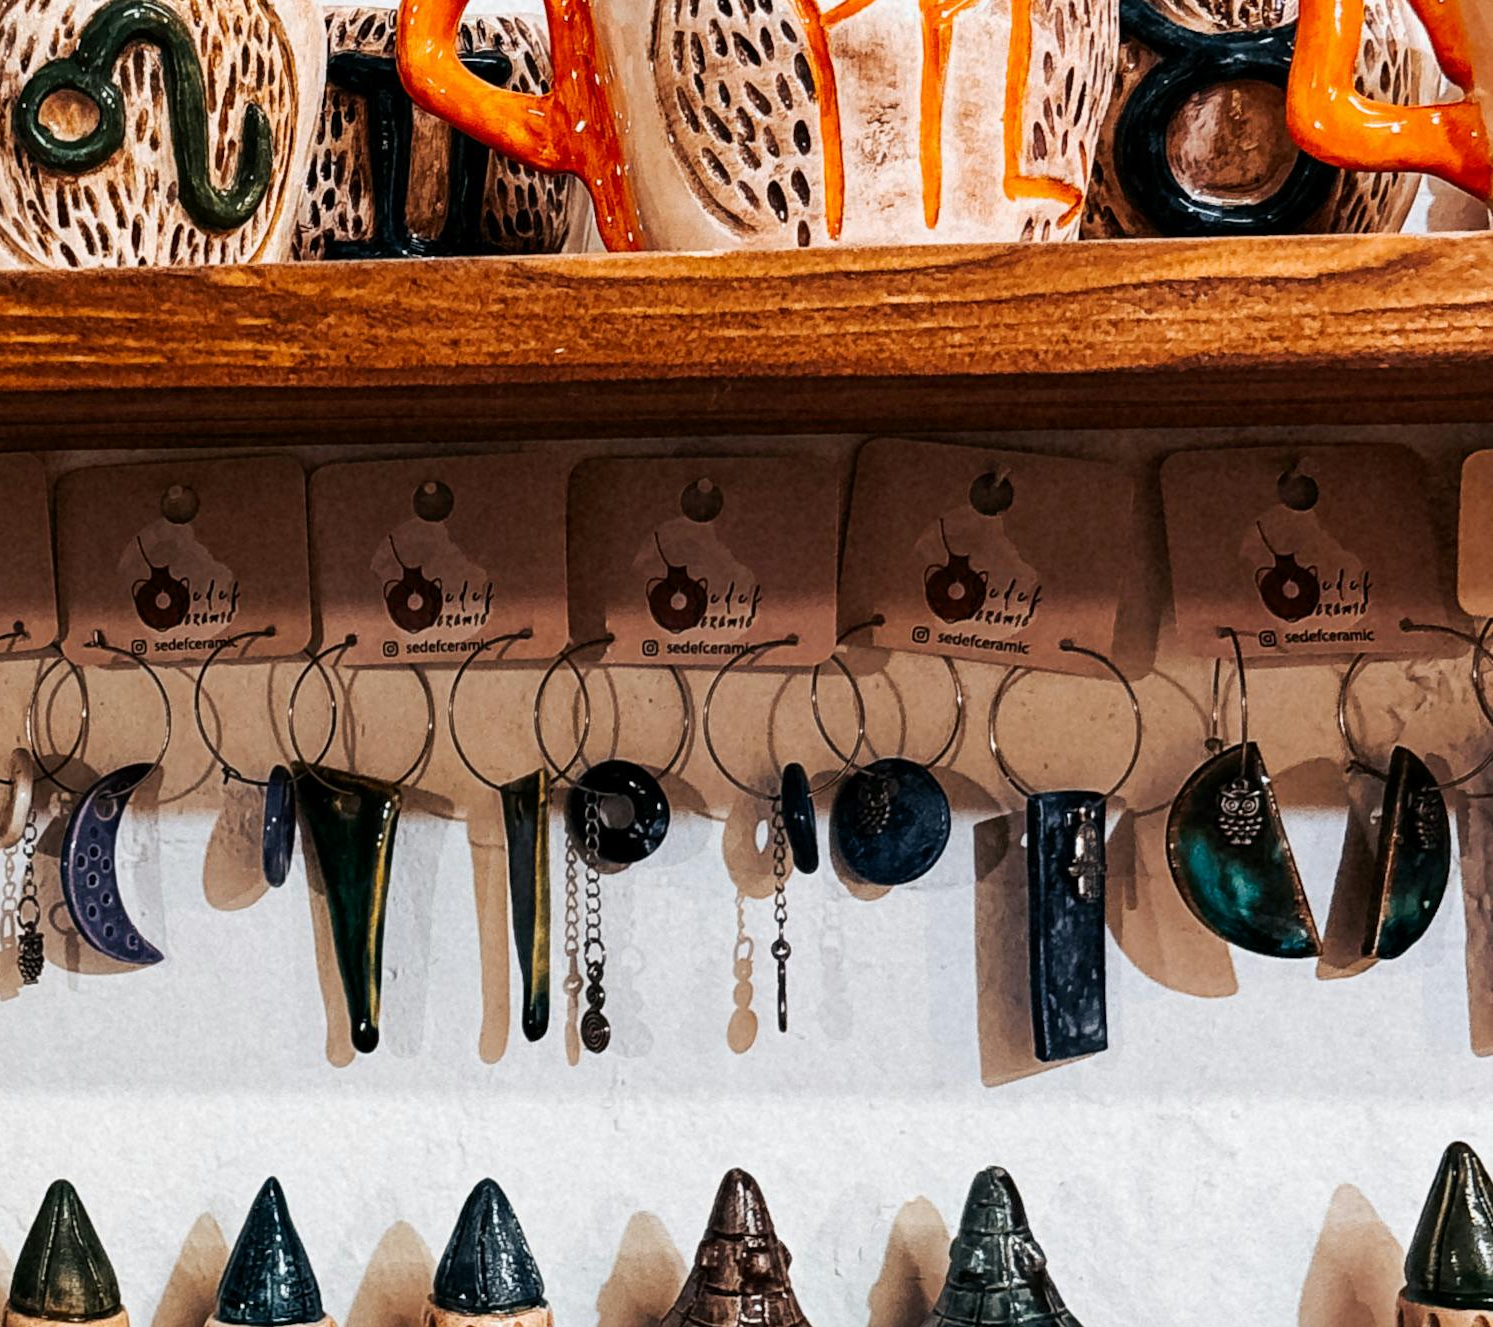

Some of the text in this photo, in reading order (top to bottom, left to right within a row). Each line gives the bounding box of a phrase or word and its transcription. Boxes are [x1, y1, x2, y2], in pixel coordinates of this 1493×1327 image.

[154, 636, 238, 651] sedefceram
[937, 633, 1030, 654] sedefceramic
[1285, 629, 1375, 643] sedefceramic
